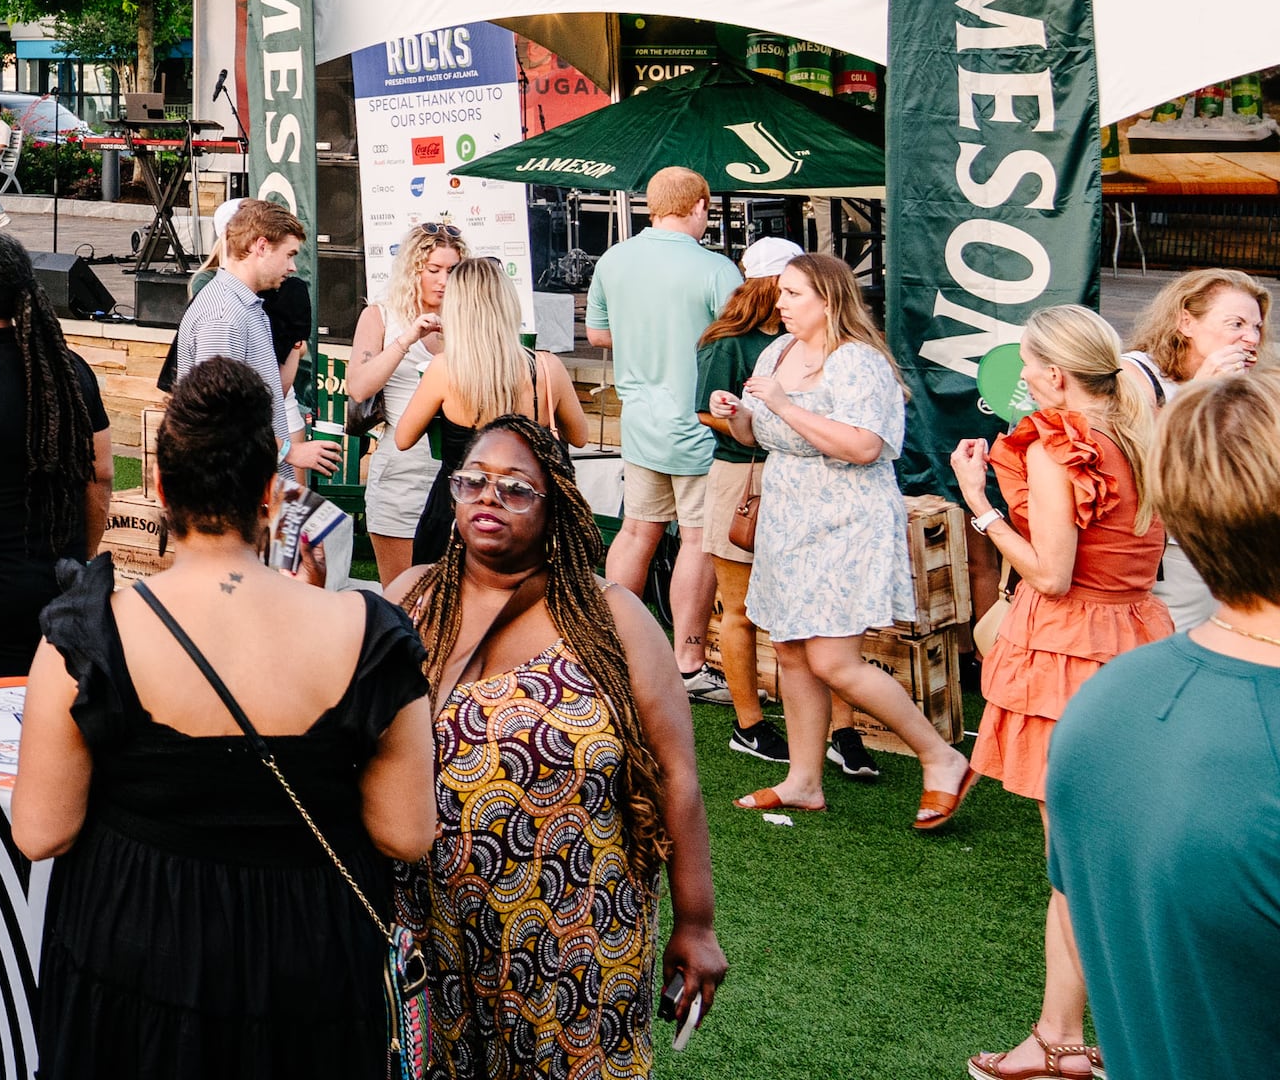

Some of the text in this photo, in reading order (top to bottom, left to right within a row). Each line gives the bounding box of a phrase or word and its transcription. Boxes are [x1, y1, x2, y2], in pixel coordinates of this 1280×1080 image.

[385, 27, 472, 76] ROCKS
[635, 48, 648, 56] FOR
[650, 48, 662, 56] THE
[663, 48, 694, 56] PERFECT
[746, 43, 785, 58] JAMESON
[787, 41, 833, 57] JAMESON
[384, 69, 479, 87] PRESENTED BY TASTE OF ATLANTA
[851, 73, 867, 82] COLA
[368, 87, 503, 112] SPECIAL THANK YOU TO
[390, 107, 482, 128] OUR SPONSORS
[515, 157, 616, 179] JAMESON
